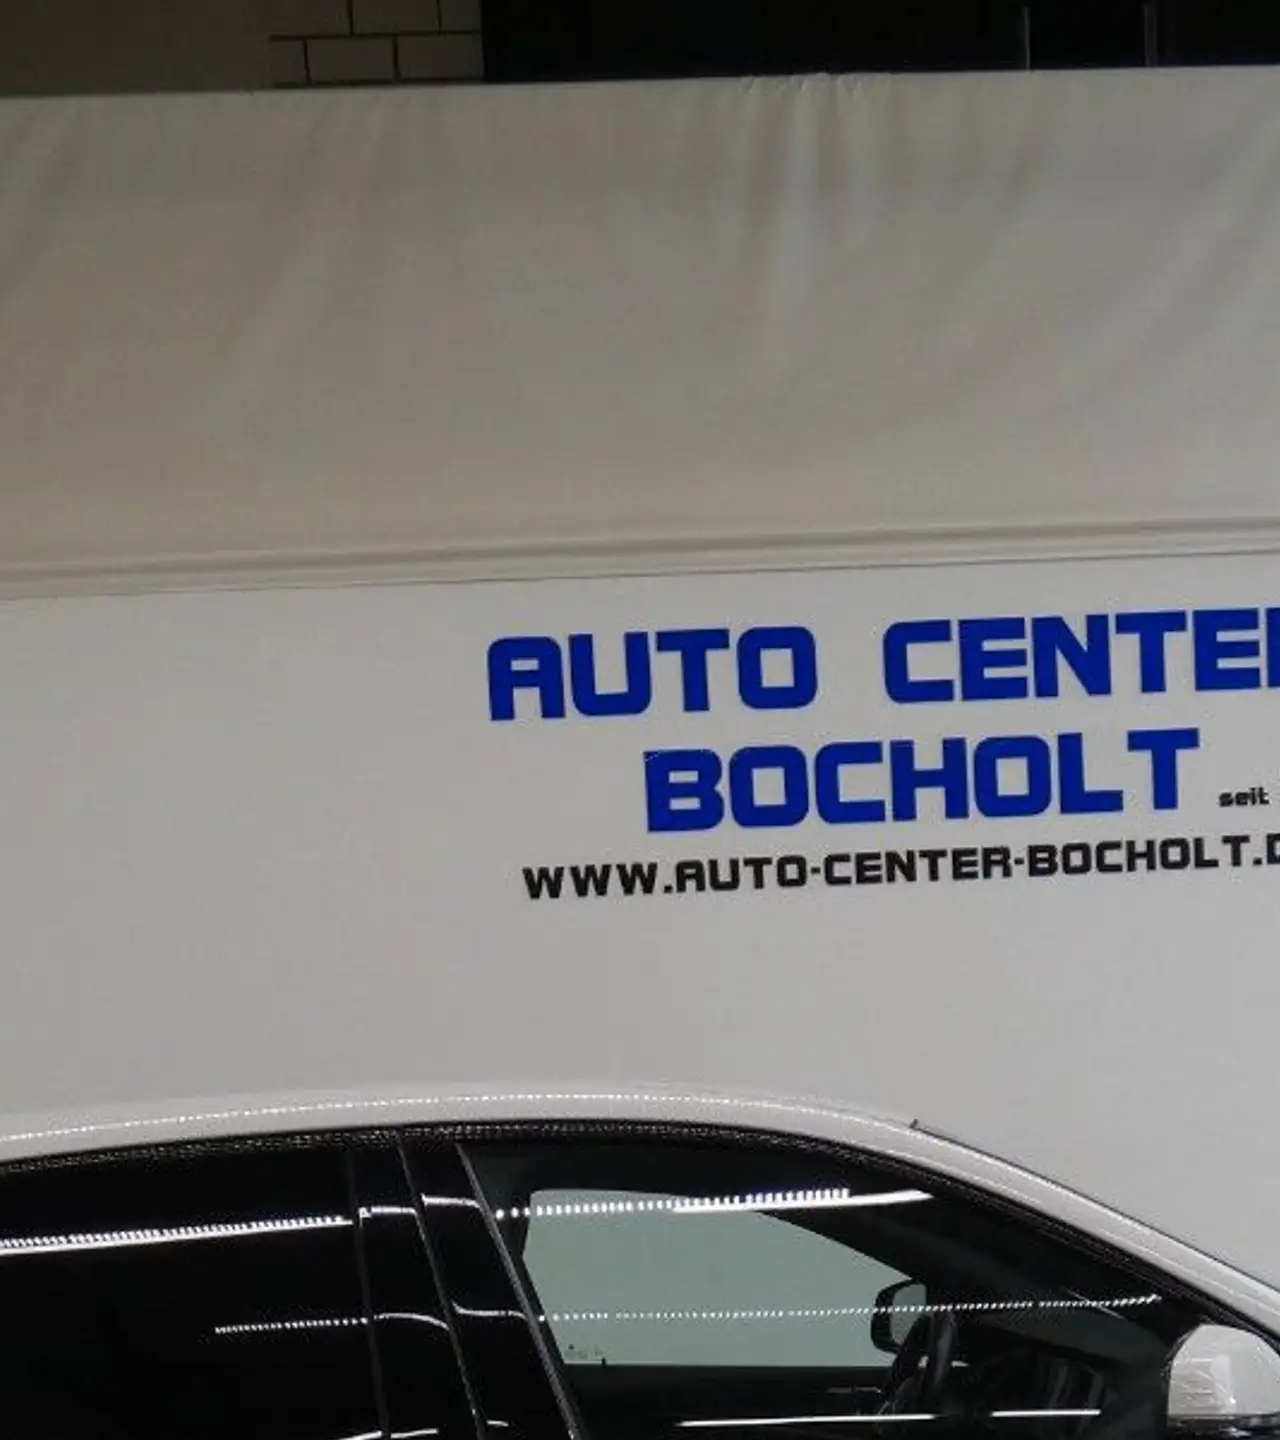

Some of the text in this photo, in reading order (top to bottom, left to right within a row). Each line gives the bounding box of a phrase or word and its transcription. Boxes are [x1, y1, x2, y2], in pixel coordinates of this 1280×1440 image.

[487, 625, 818, 721] AUTO
[644, 728, 1200, 833] BOCHOLT
[1218, 786, 1270, 808] seit
